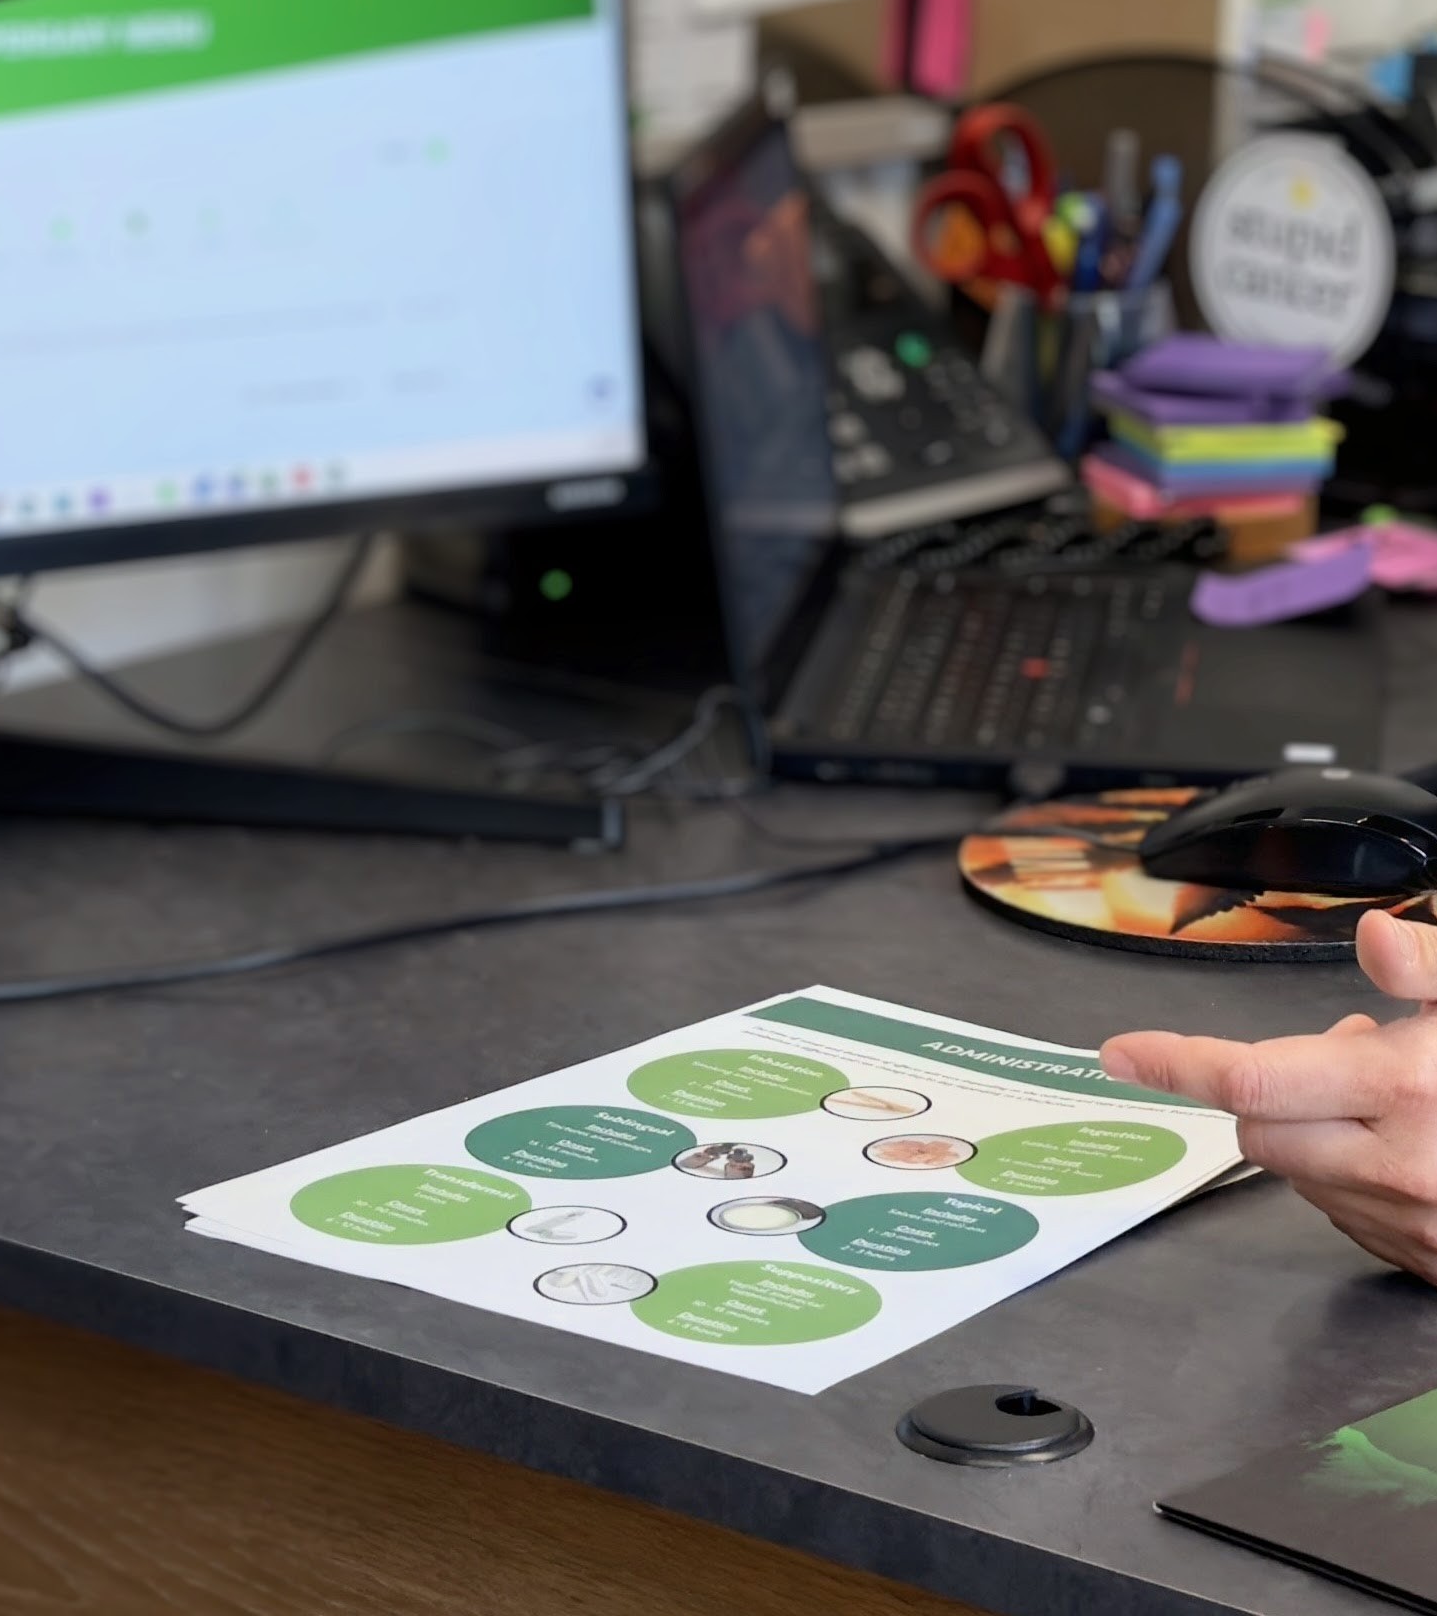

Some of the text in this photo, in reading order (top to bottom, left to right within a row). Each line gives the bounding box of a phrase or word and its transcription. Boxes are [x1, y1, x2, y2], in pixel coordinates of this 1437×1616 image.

[748, 1054, 823, 1078] Inhalation
[594, 1111, 676, 1137] Sublingual
[1078, 1126, 1152, 1141] Ingestion
[423, 1168, 518, 1201] Transdermal
[943, 1196, 1003, 1215] Topical
[760, 1263, 861, 1295] Suppository
